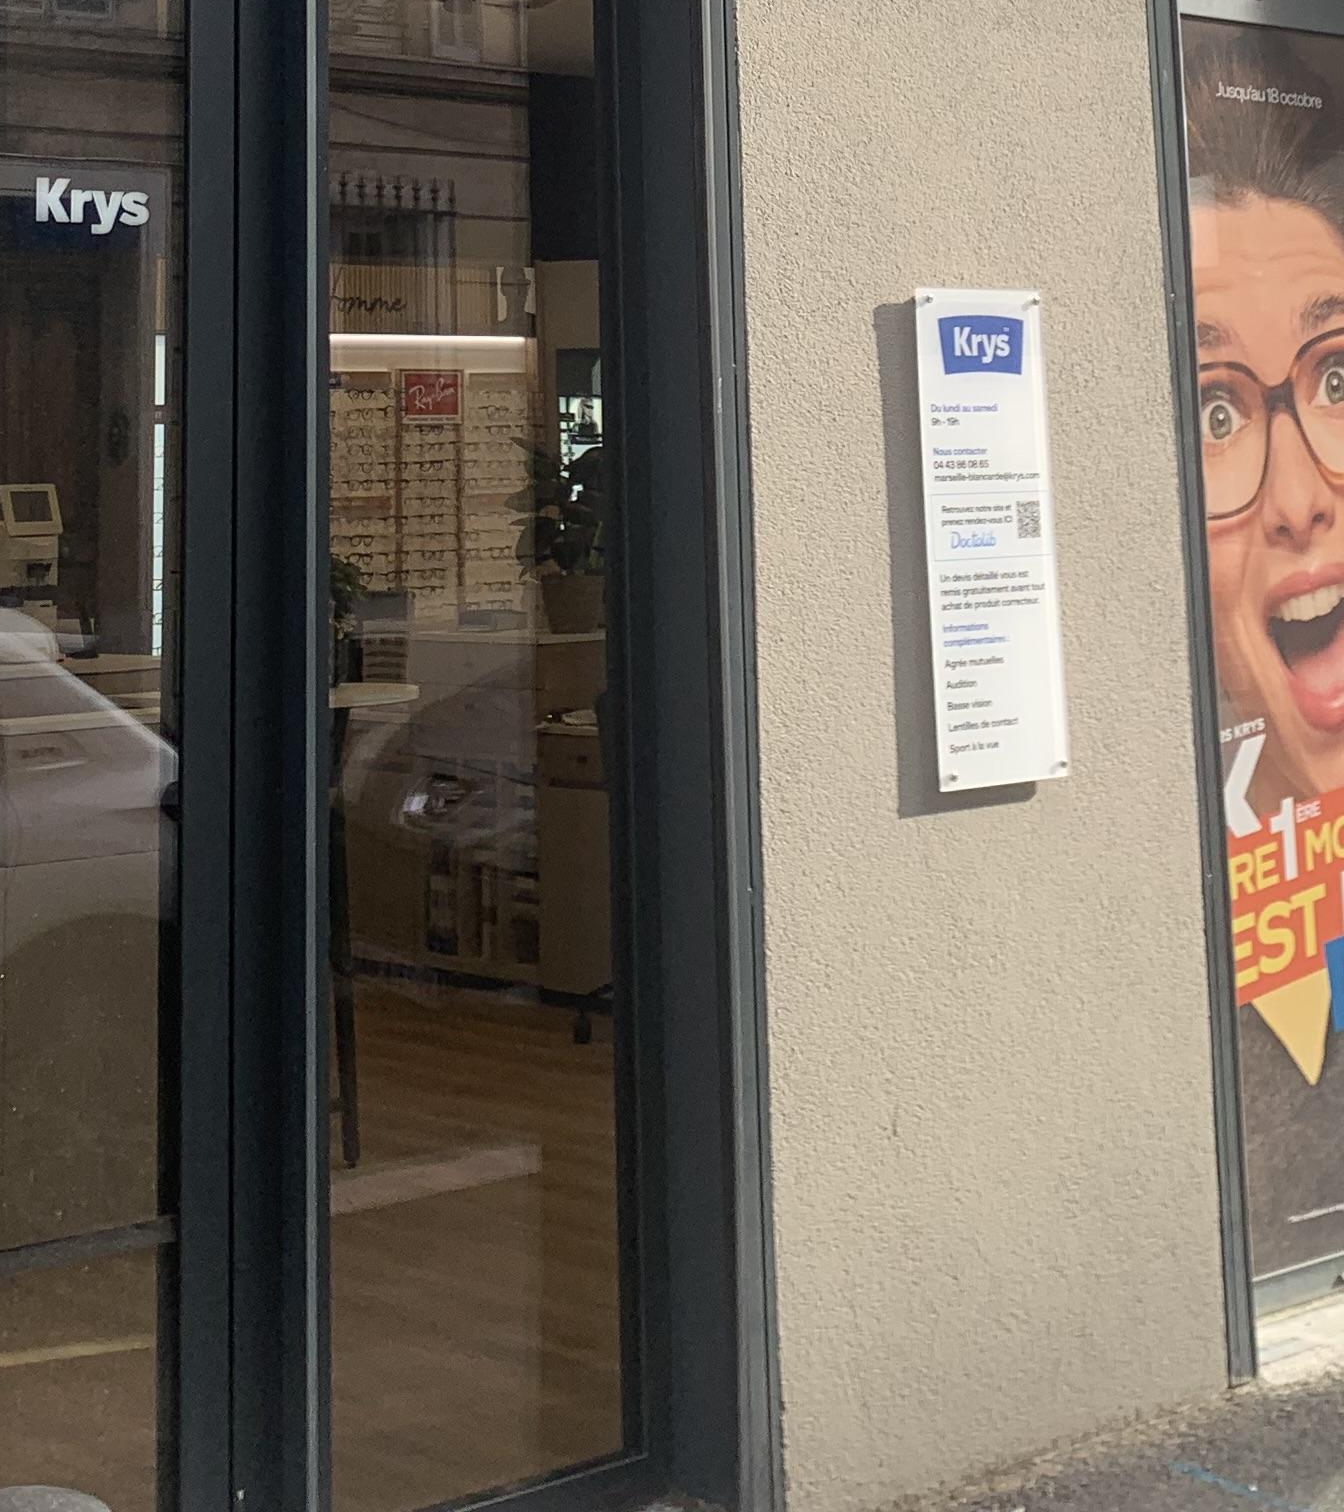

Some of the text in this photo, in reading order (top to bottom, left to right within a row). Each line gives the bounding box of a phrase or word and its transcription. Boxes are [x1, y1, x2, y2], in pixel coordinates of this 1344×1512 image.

[1267, 87, 1279, 103] 18
[1280, 92, 1323, 109] octobre
[36, 176, 150, 235] Krys
[330, 267, 407, 313] omme
[953, 326, 1010, 363] Krys
[930, 404, 941, 413] Du
[943, 404, 960, 412] lundi
[973, 403, 998, 412] samedi
[933, 447, 988, 456] Nous contacter
[940, 574, 951, 583] Un
[952, 573, 971, 582] devis
[1000, 572, 1017, 580] vous
[1018, 570, 1029, 578] est
[940, 583, 1045, 598] remis gratuitement avant tout
[942, 601, 962, 611] achat
[963, 600, 973, 609] de
[974, 599, 1001, 611] produit
[946, 679, 977, 690] Audition
[947, 698, 992, 711] Basse vision
[948, 716, 1018, 732] Lentilles de contact
[1234, 717, 1265, 739] KRYS
[949, 745, 970, 756] Sport
[986, 741, 999, 749] vue
